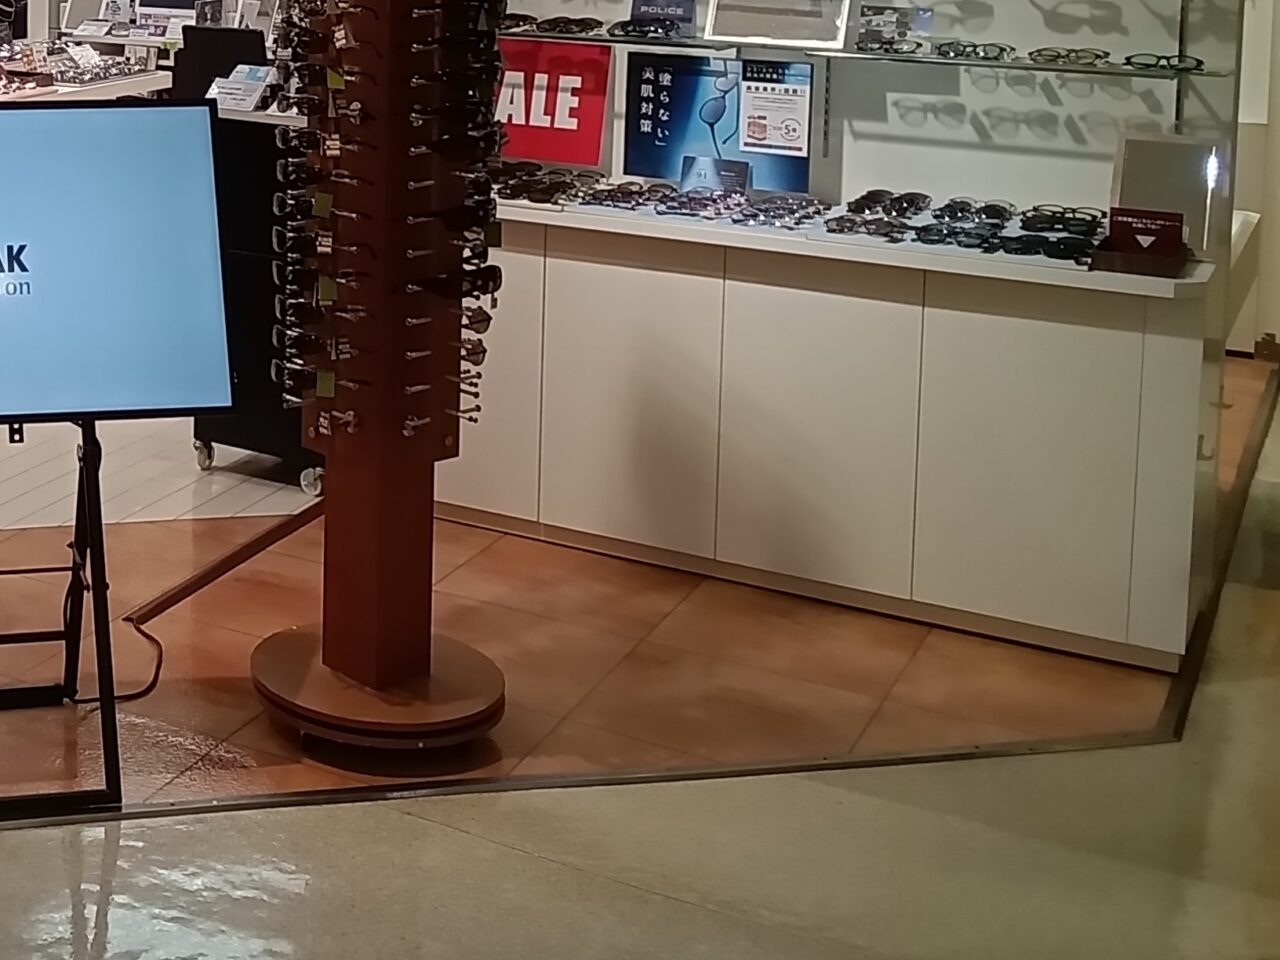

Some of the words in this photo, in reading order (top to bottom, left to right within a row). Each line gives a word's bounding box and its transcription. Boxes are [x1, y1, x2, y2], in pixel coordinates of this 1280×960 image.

[641, 5, 684, 15] POLICE
[494, 70, 582, 130] ALE
[639, 66, 656, 133] 美肌対策
[655, 66, 673, 147] 「塗らない」
[5, 280, 31, 296] on
